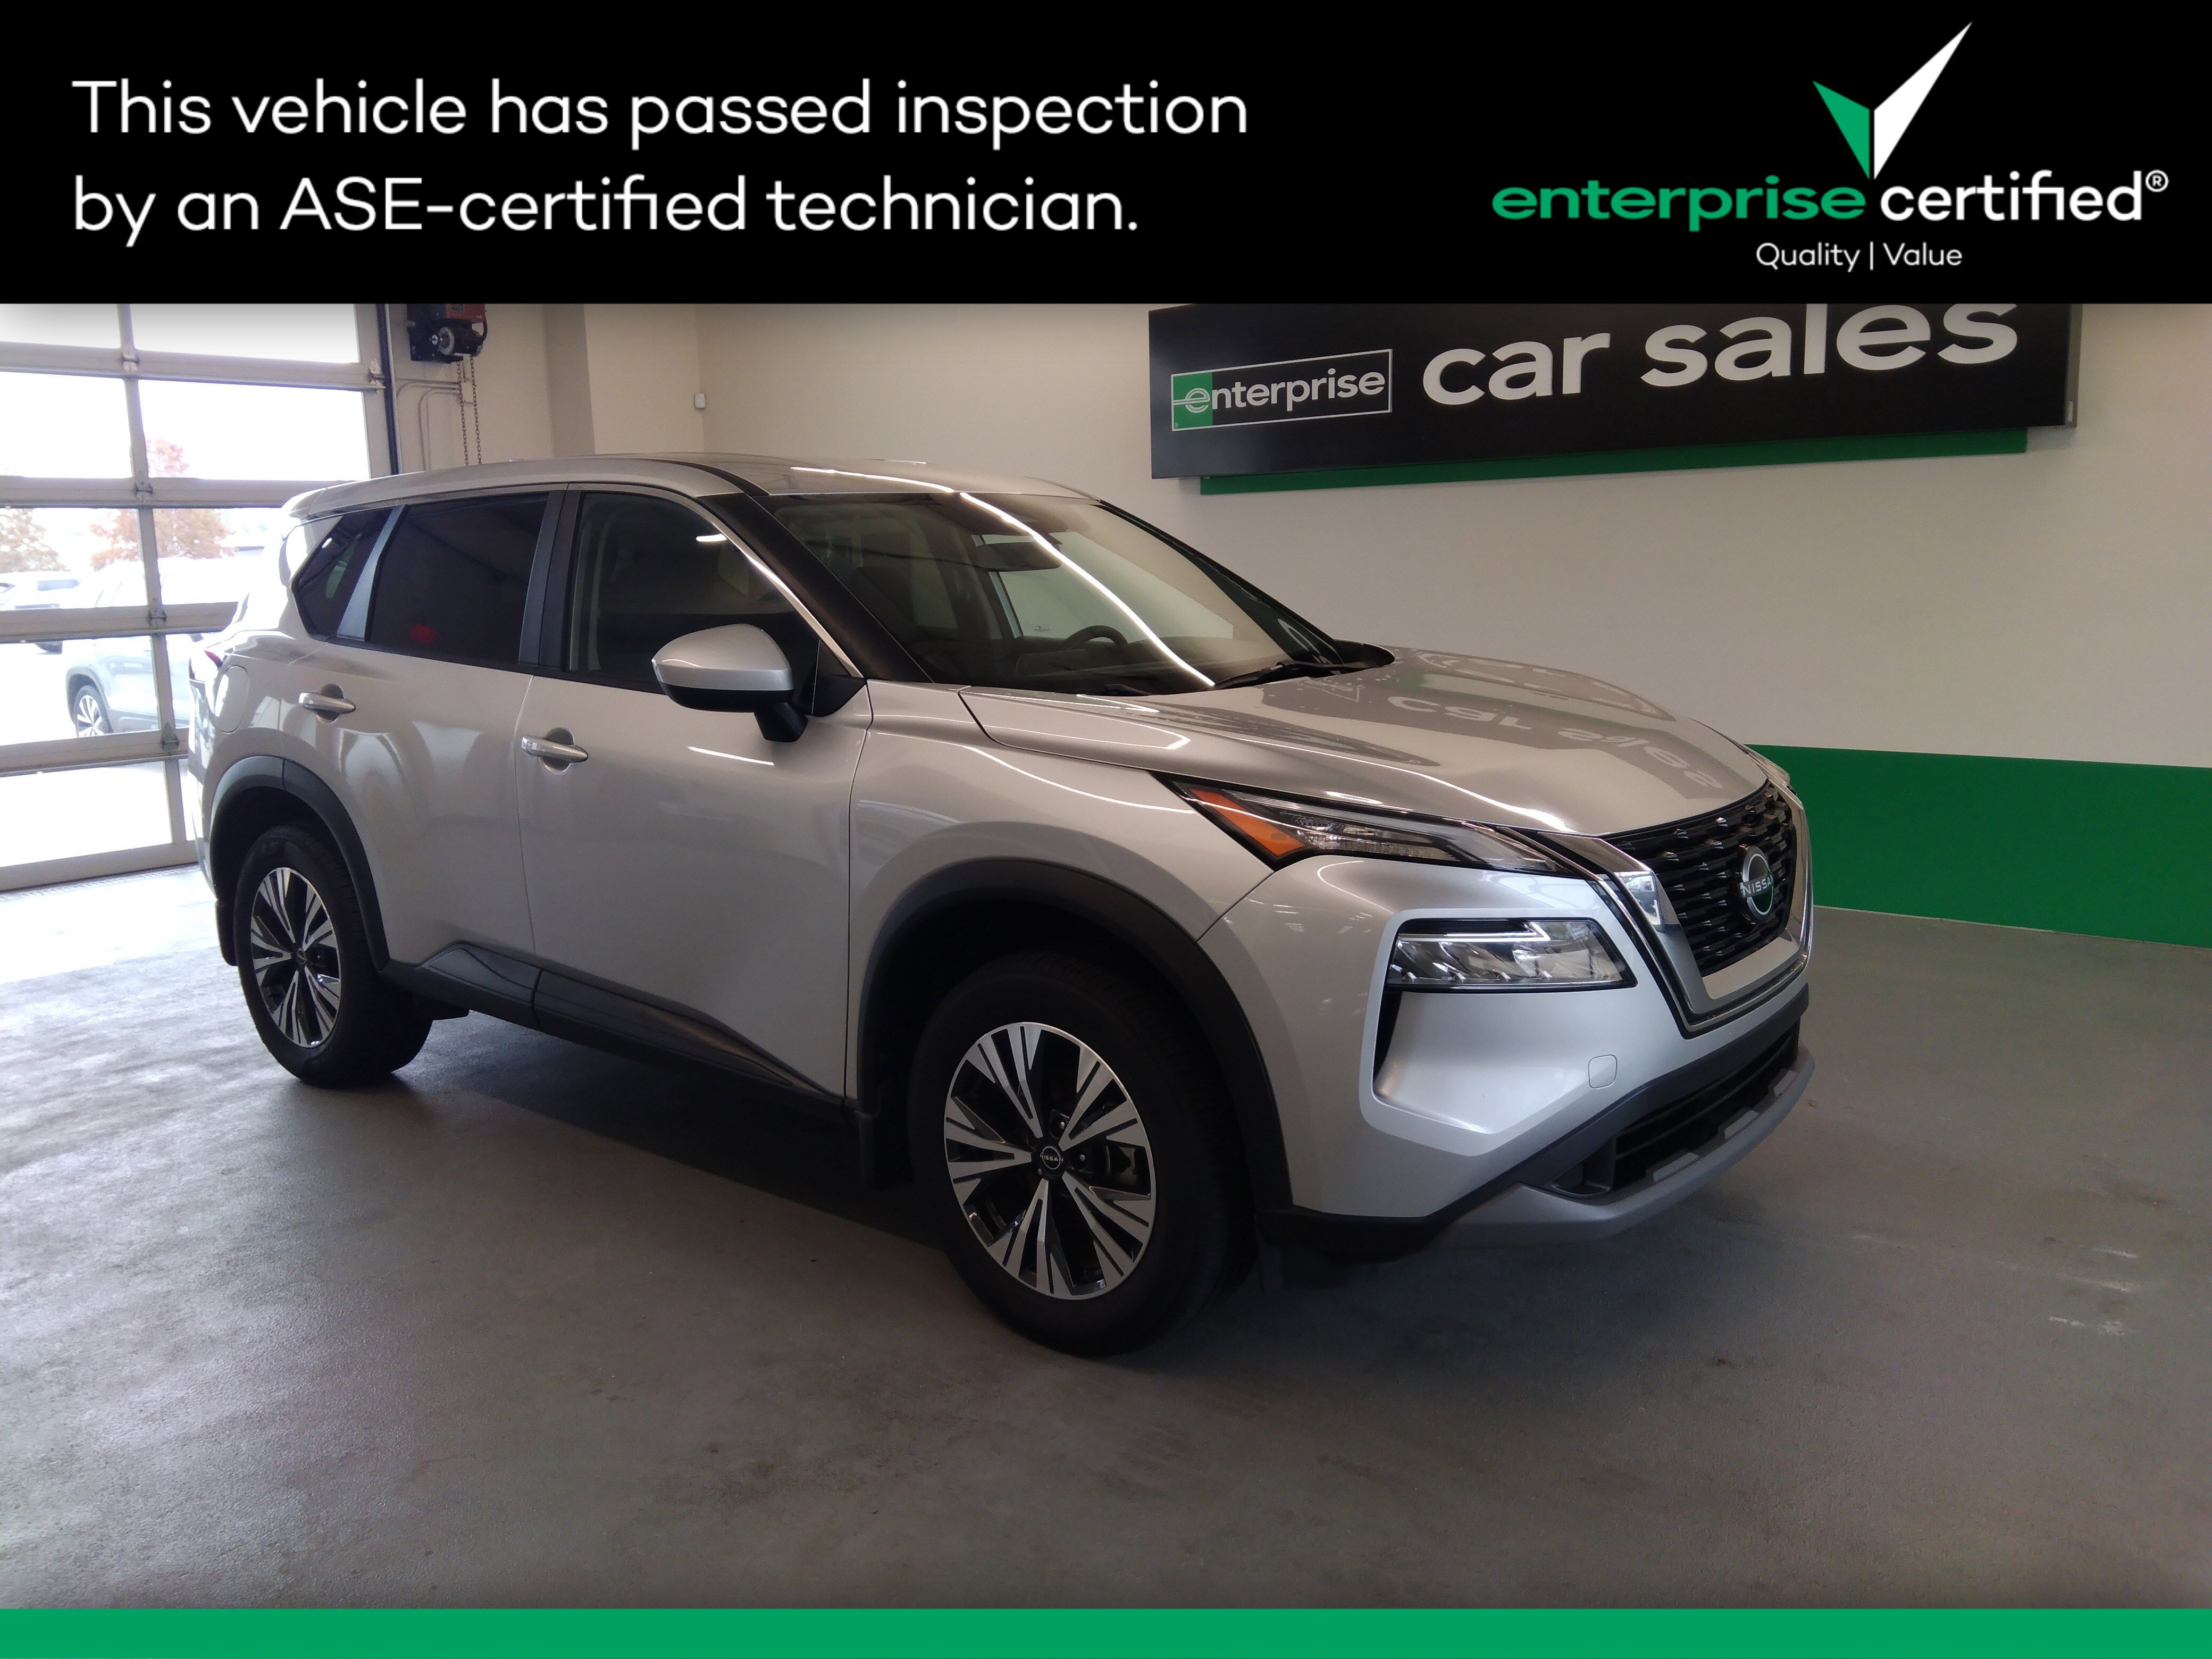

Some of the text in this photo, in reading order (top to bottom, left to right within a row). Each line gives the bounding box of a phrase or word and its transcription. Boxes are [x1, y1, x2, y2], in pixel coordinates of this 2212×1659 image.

[1184, 368, 1386, 413] enterprise
[1423, 304, 2018, 406] car sales
